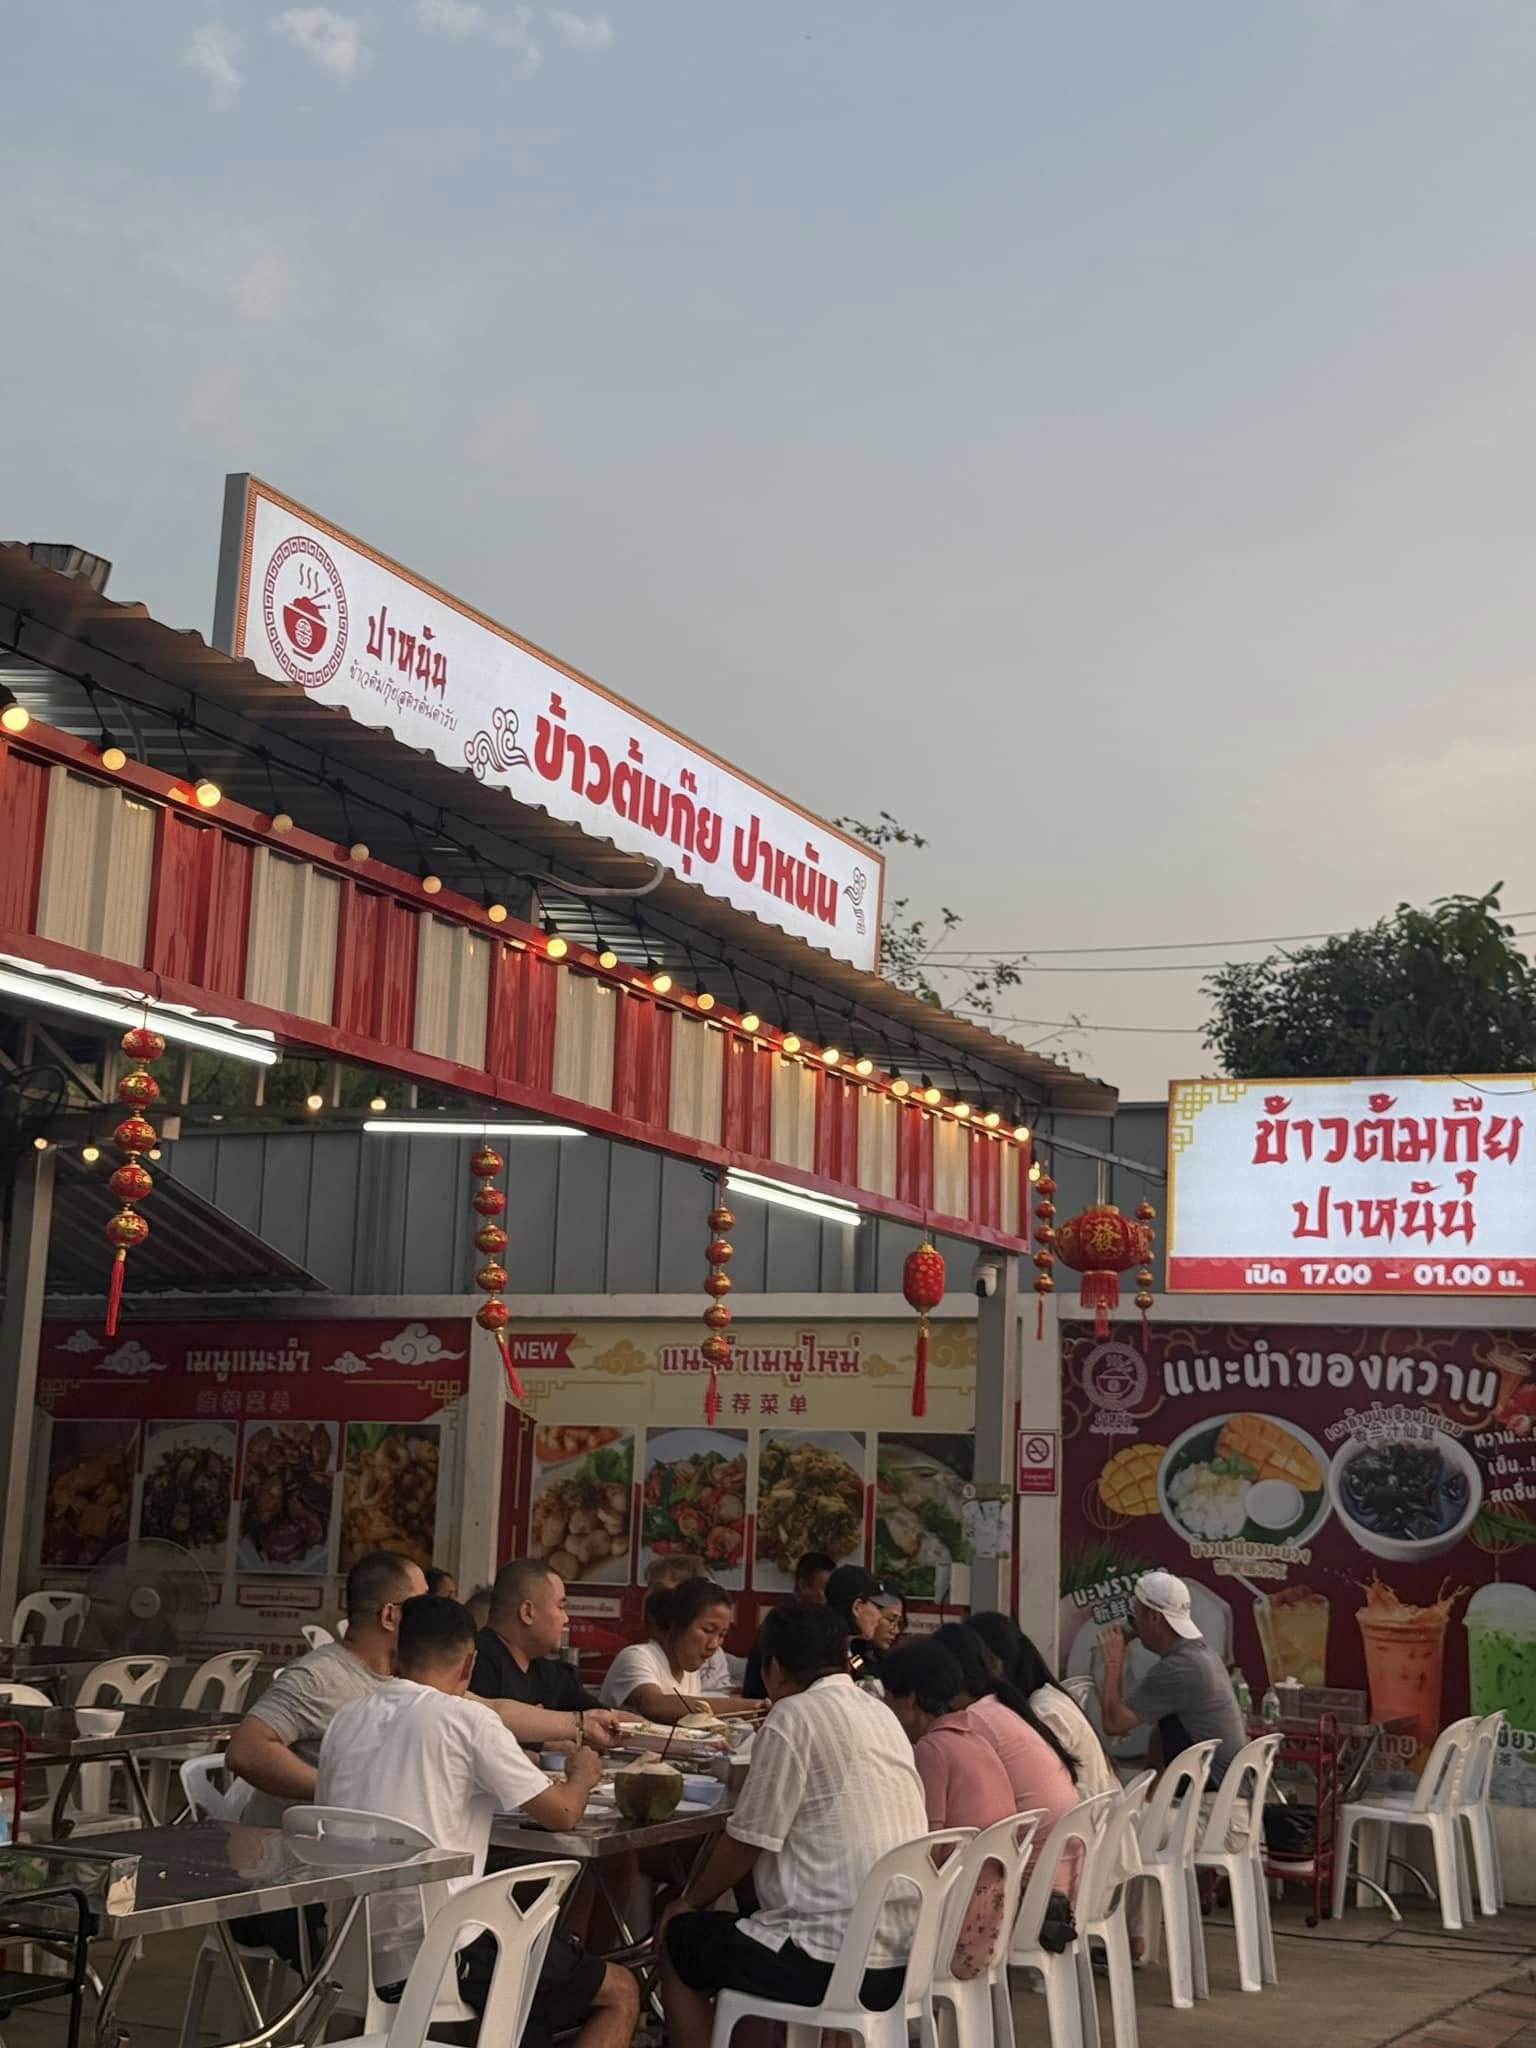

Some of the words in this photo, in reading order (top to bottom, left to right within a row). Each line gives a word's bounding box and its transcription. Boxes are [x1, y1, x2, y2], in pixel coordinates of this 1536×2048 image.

[366, 605, 447, 700] ปาหนัน
[534, 691, 723, 876] ข้าวต้มกุ๊ย
[732, 814, 839, 928] ปาหนัน
[1252, 1093, 1523, 1195] ข้าวต้มกุ๊ย
[1292, 1181, 1476, 1246] ปาหนัน
[1245, 1263, 1287, 1286] เปิด
[1300, 1264, 1372, 1286] 17.00
[1413, 1265, 1491, 1286] 01.00
[1497, 1269, 1525, 1287] น.
[186, 1337, 310, 1382] เมนูแนะนำ
[513, 1340, 559, 1360] NEW
[662, 1334, 860, 1382] แนนำเมนูใหม่
[1162, 1340, 1498, 1408] แนะนำของหวาน
[1093, 1597, 1136, 1624] 新鲜
